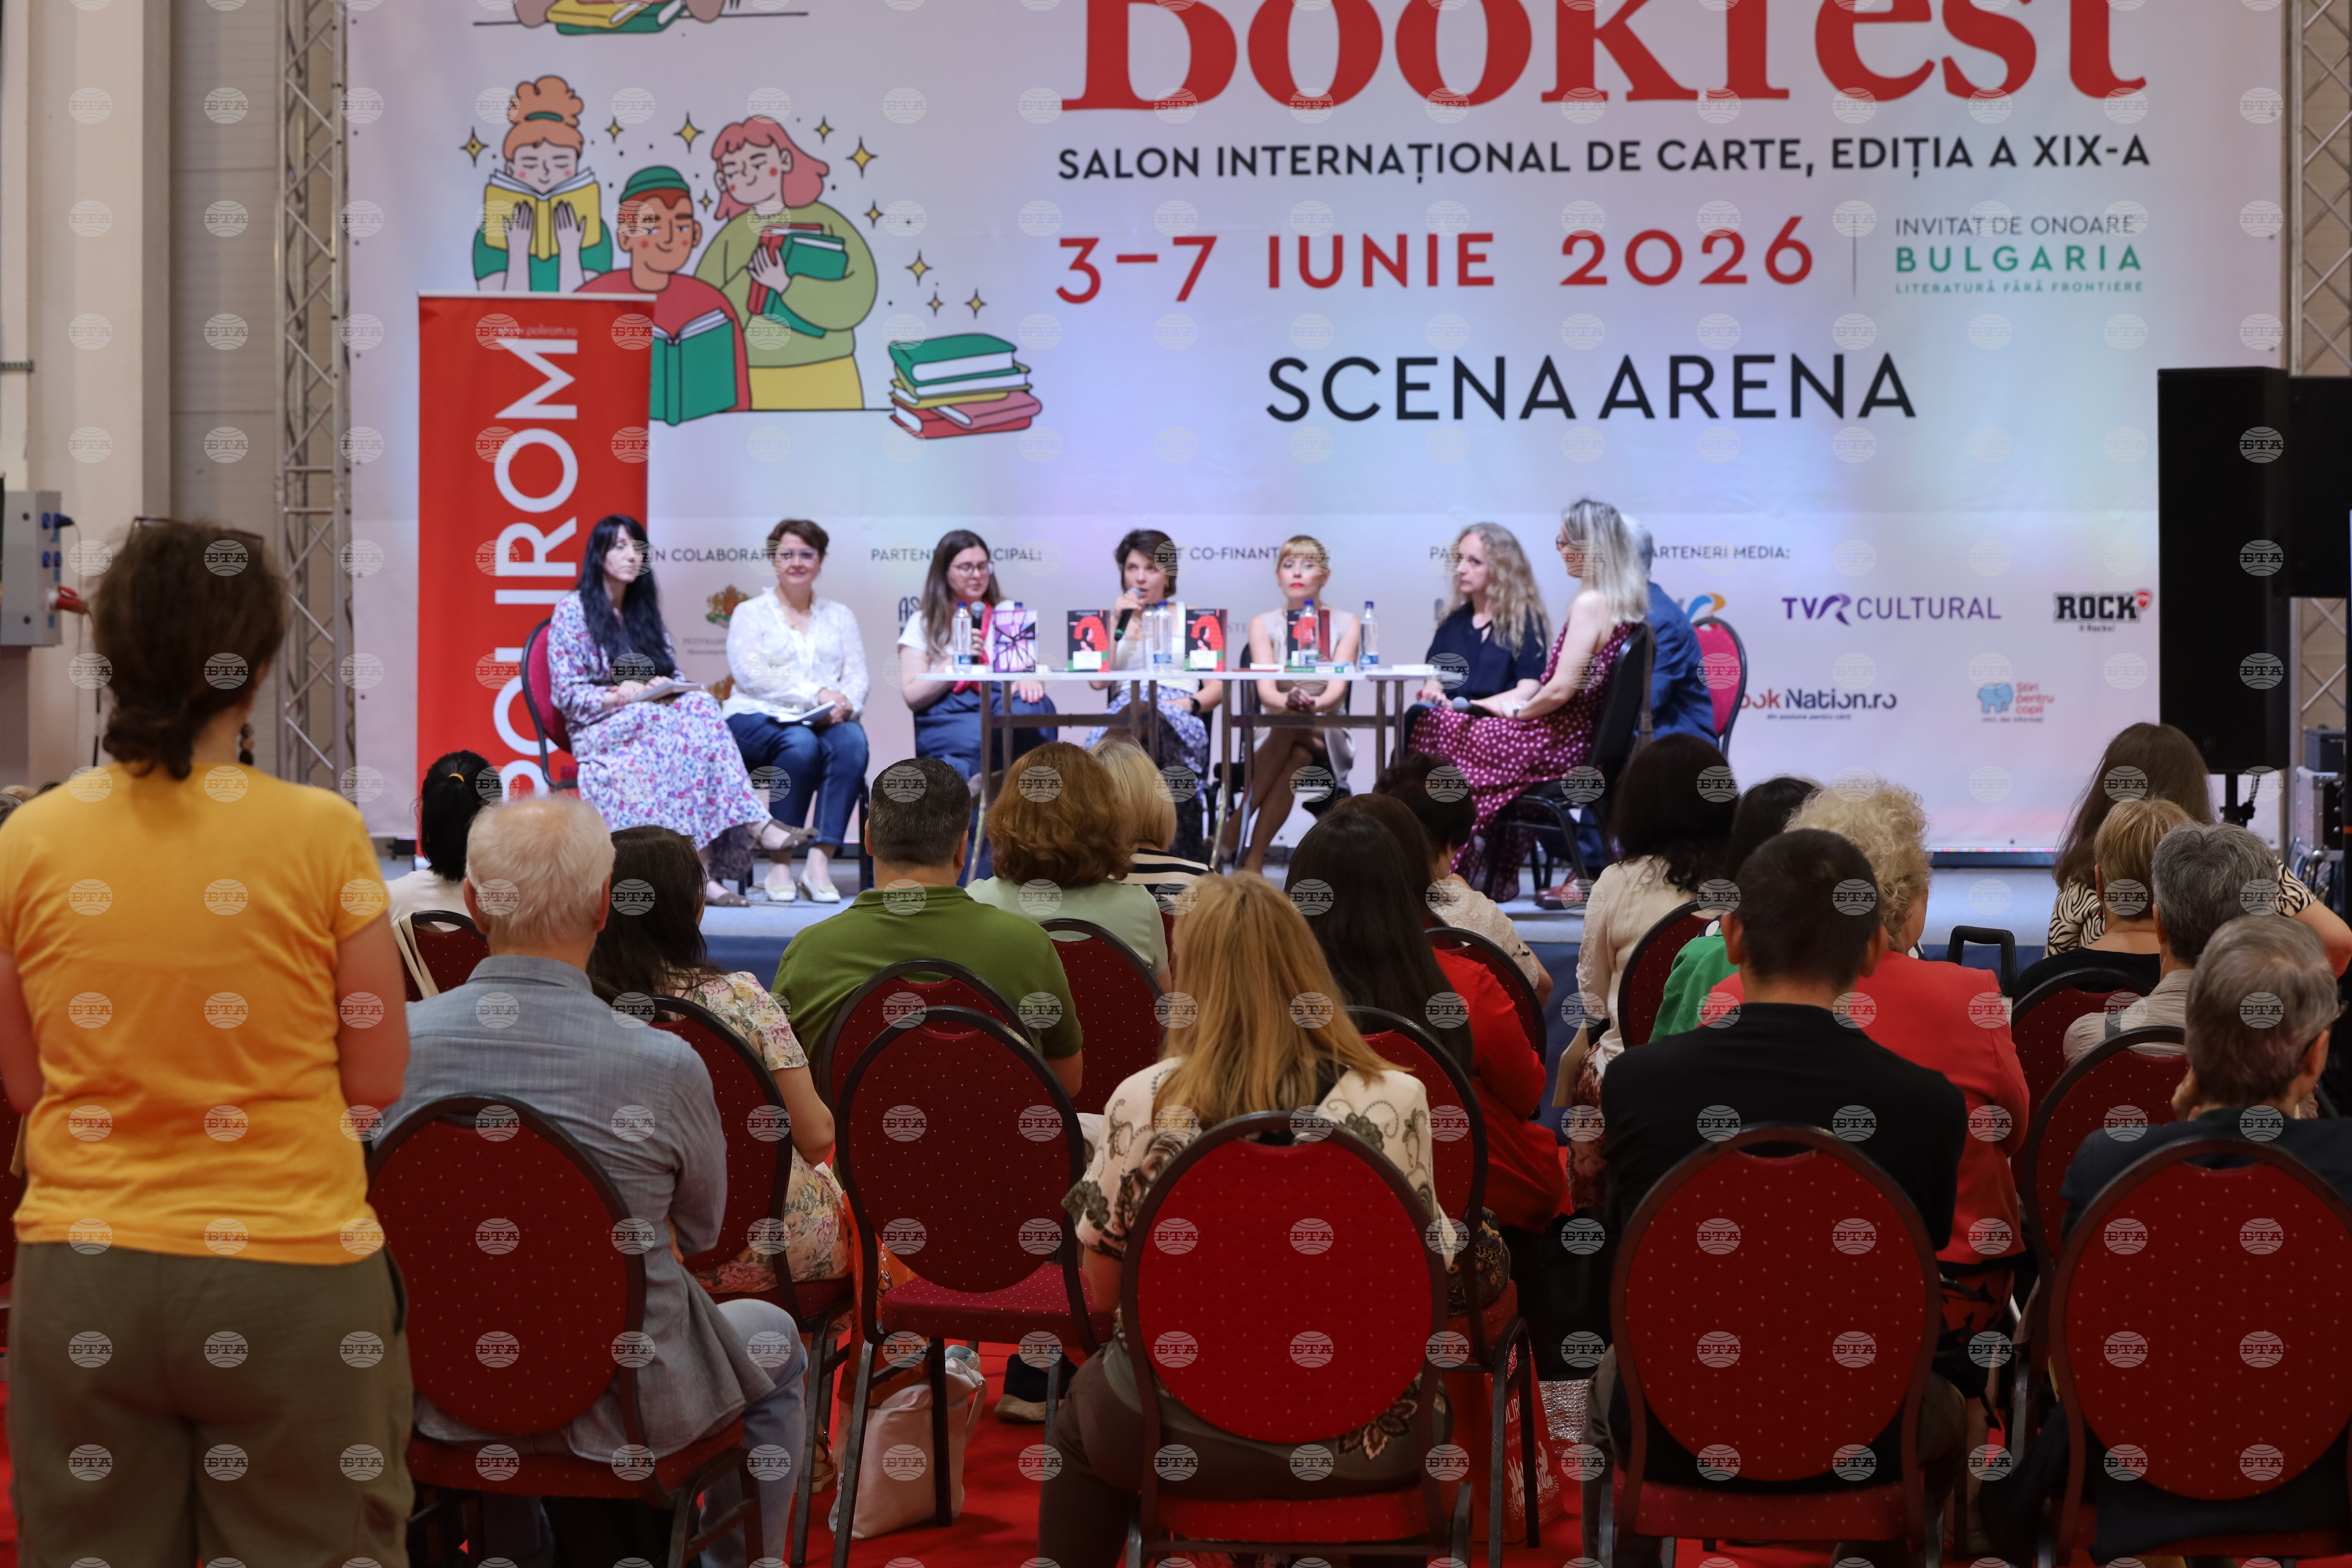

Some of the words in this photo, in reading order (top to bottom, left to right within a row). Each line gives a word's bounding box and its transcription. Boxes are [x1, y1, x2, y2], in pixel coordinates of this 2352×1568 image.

[1058, 147, 1199, 180] SALON
[1217, 141, 1571, 184] INTERNAȚIONAL
[1587, 140, 1642, 172] DE
[1657, 138, 1814, 178] CARTE,
[1831, 136, 1974, 179] EDIȚIA
[1989, 136, 2017, 168] A
[2034, 135, 2150, 167] XIX-A
[1895, 216, 1983, 236] INVITAT
[1992, 216, 2021, 235] DE
[2030, 215, 2135, 235] ONOARE
[1268, 233, 1494, 289] IUNIE
[1560, 216, 1813, 286] 2026
[1896, 245, 2141, 273] BULGARIA
[1895, 280, 1995, 294] LITERATURĂ
[2003, 280, 2043, 293] FĂRĂ
[2051, 281, 2142, 293] FRONTIERE
[1266, 355, 1577, 423] SCENA
[1598, 352, 1917, 420] ARENA
[671, 548, 767, 562] COLABORA
[871, 548, 934, 561] PARTEN
[991, 547, 1042, 561] CIPAL:
[1734, 545, 1790, 559] MEDIA:
[1857, 597, 2001, 619] CULTURAL
[2056, 596, 2137, 619] ROCK
